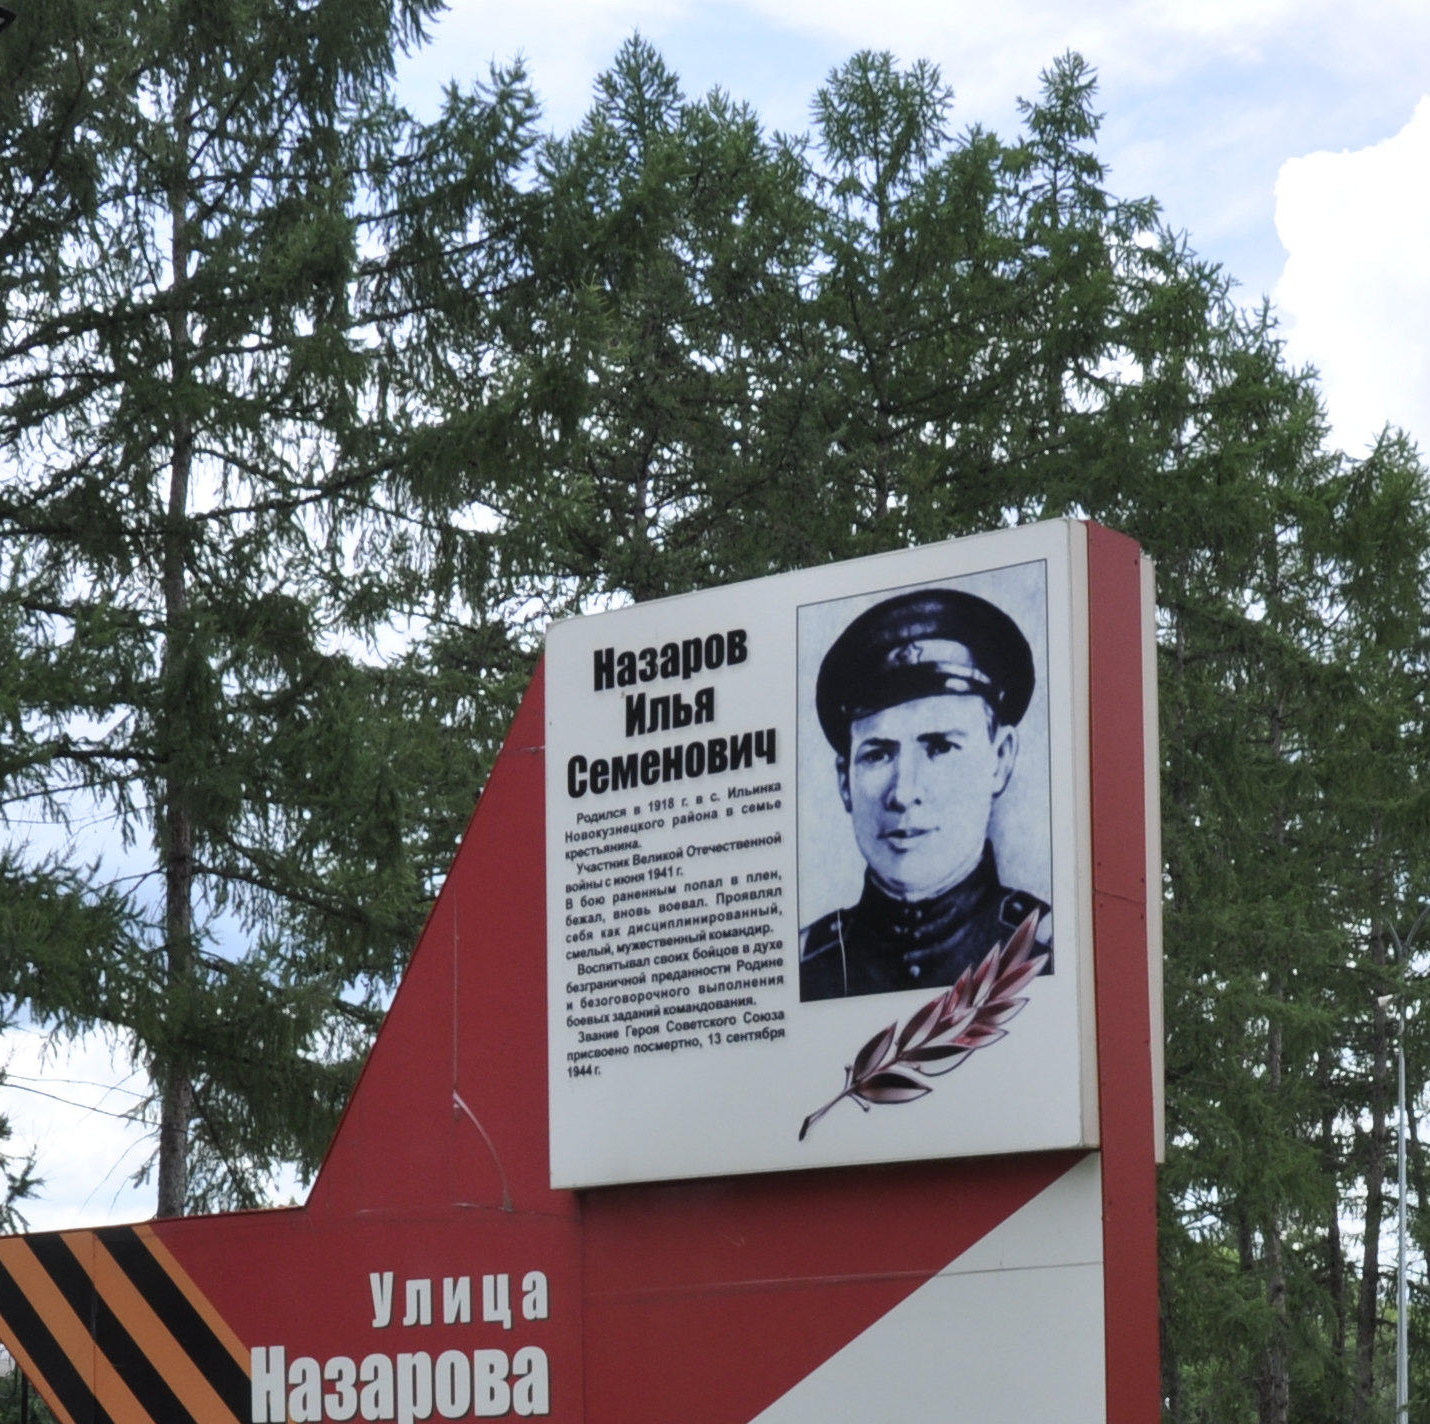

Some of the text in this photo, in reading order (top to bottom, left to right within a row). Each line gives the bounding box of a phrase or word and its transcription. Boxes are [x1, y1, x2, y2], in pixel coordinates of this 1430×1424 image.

[594, 629, 747, 691] Назаров
[625, 687, 714, 737] Илья
[567, 728, 776, 798] Семенович
[565, 800, 781, 843] Новокузнецкого района в семье
[577, 782, 781, 824] Родился в 1918 г. в с. Ильинка
[565, 840, 641, 860] крестьянина.
[576, 831, 782, 875] Участник Великой Отечественной
[565, 865, 683, 893] войны с июня 1941 г.
[565, 870, 782, 910] В бою раненным попал в плен,
[565, 887, 782, 926] бежал, вновь воевал. Проявлял
[566, 902, 782, 943] себя как дисциплинированный,
[566, 924, 773, 960] смелый, мужественный командир.
[577, 940, 783, 975] Воспитывал своих бойцов в духе
[566, 957, 783, 994] безграничной преданности Родине
[566, 975, 784, 1010] и безоговорочного выполнения
[566, 996, 756, 1027] боевых заданий командования.
[578, 1010, 785, 1043] Звание Героя Советского Союза
[567, 1027, 785, 1063] присвоено посмертно, 13 сентября
[567, 1064, 601, 1078] 1944 г.
[369, 1270, 549, 1329] Улица
